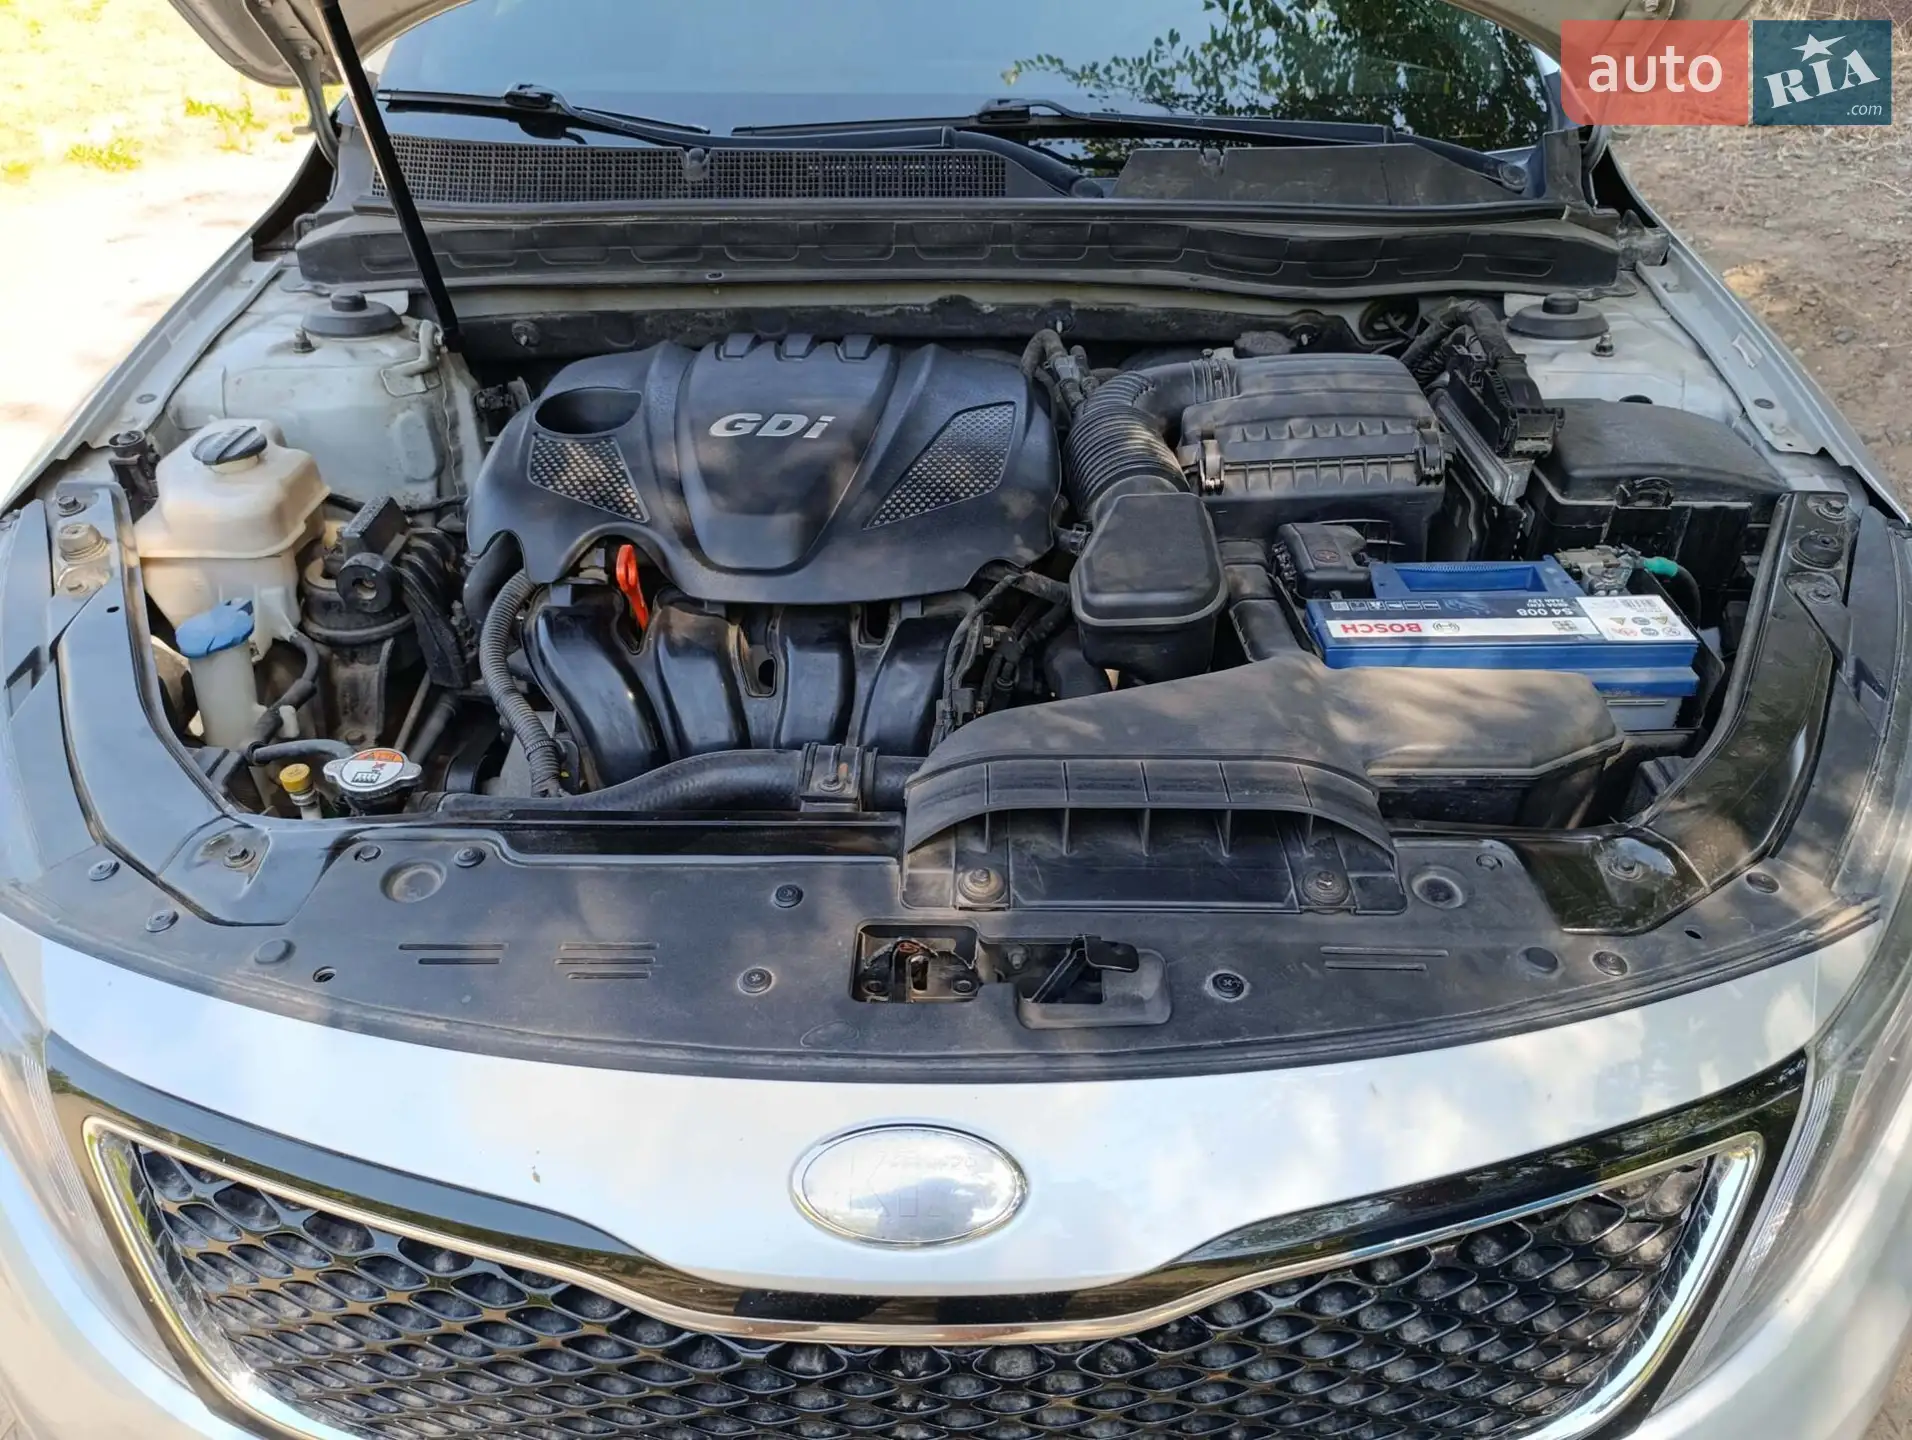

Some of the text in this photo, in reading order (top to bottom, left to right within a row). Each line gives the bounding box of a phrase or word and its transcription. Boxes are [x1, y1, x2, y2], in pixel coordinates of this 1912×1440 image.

[708, 413, 836, 439] GDi
[1516, 608, 1574, 616] S4 008
[1340, 622, 1423, 634] BOSCH
